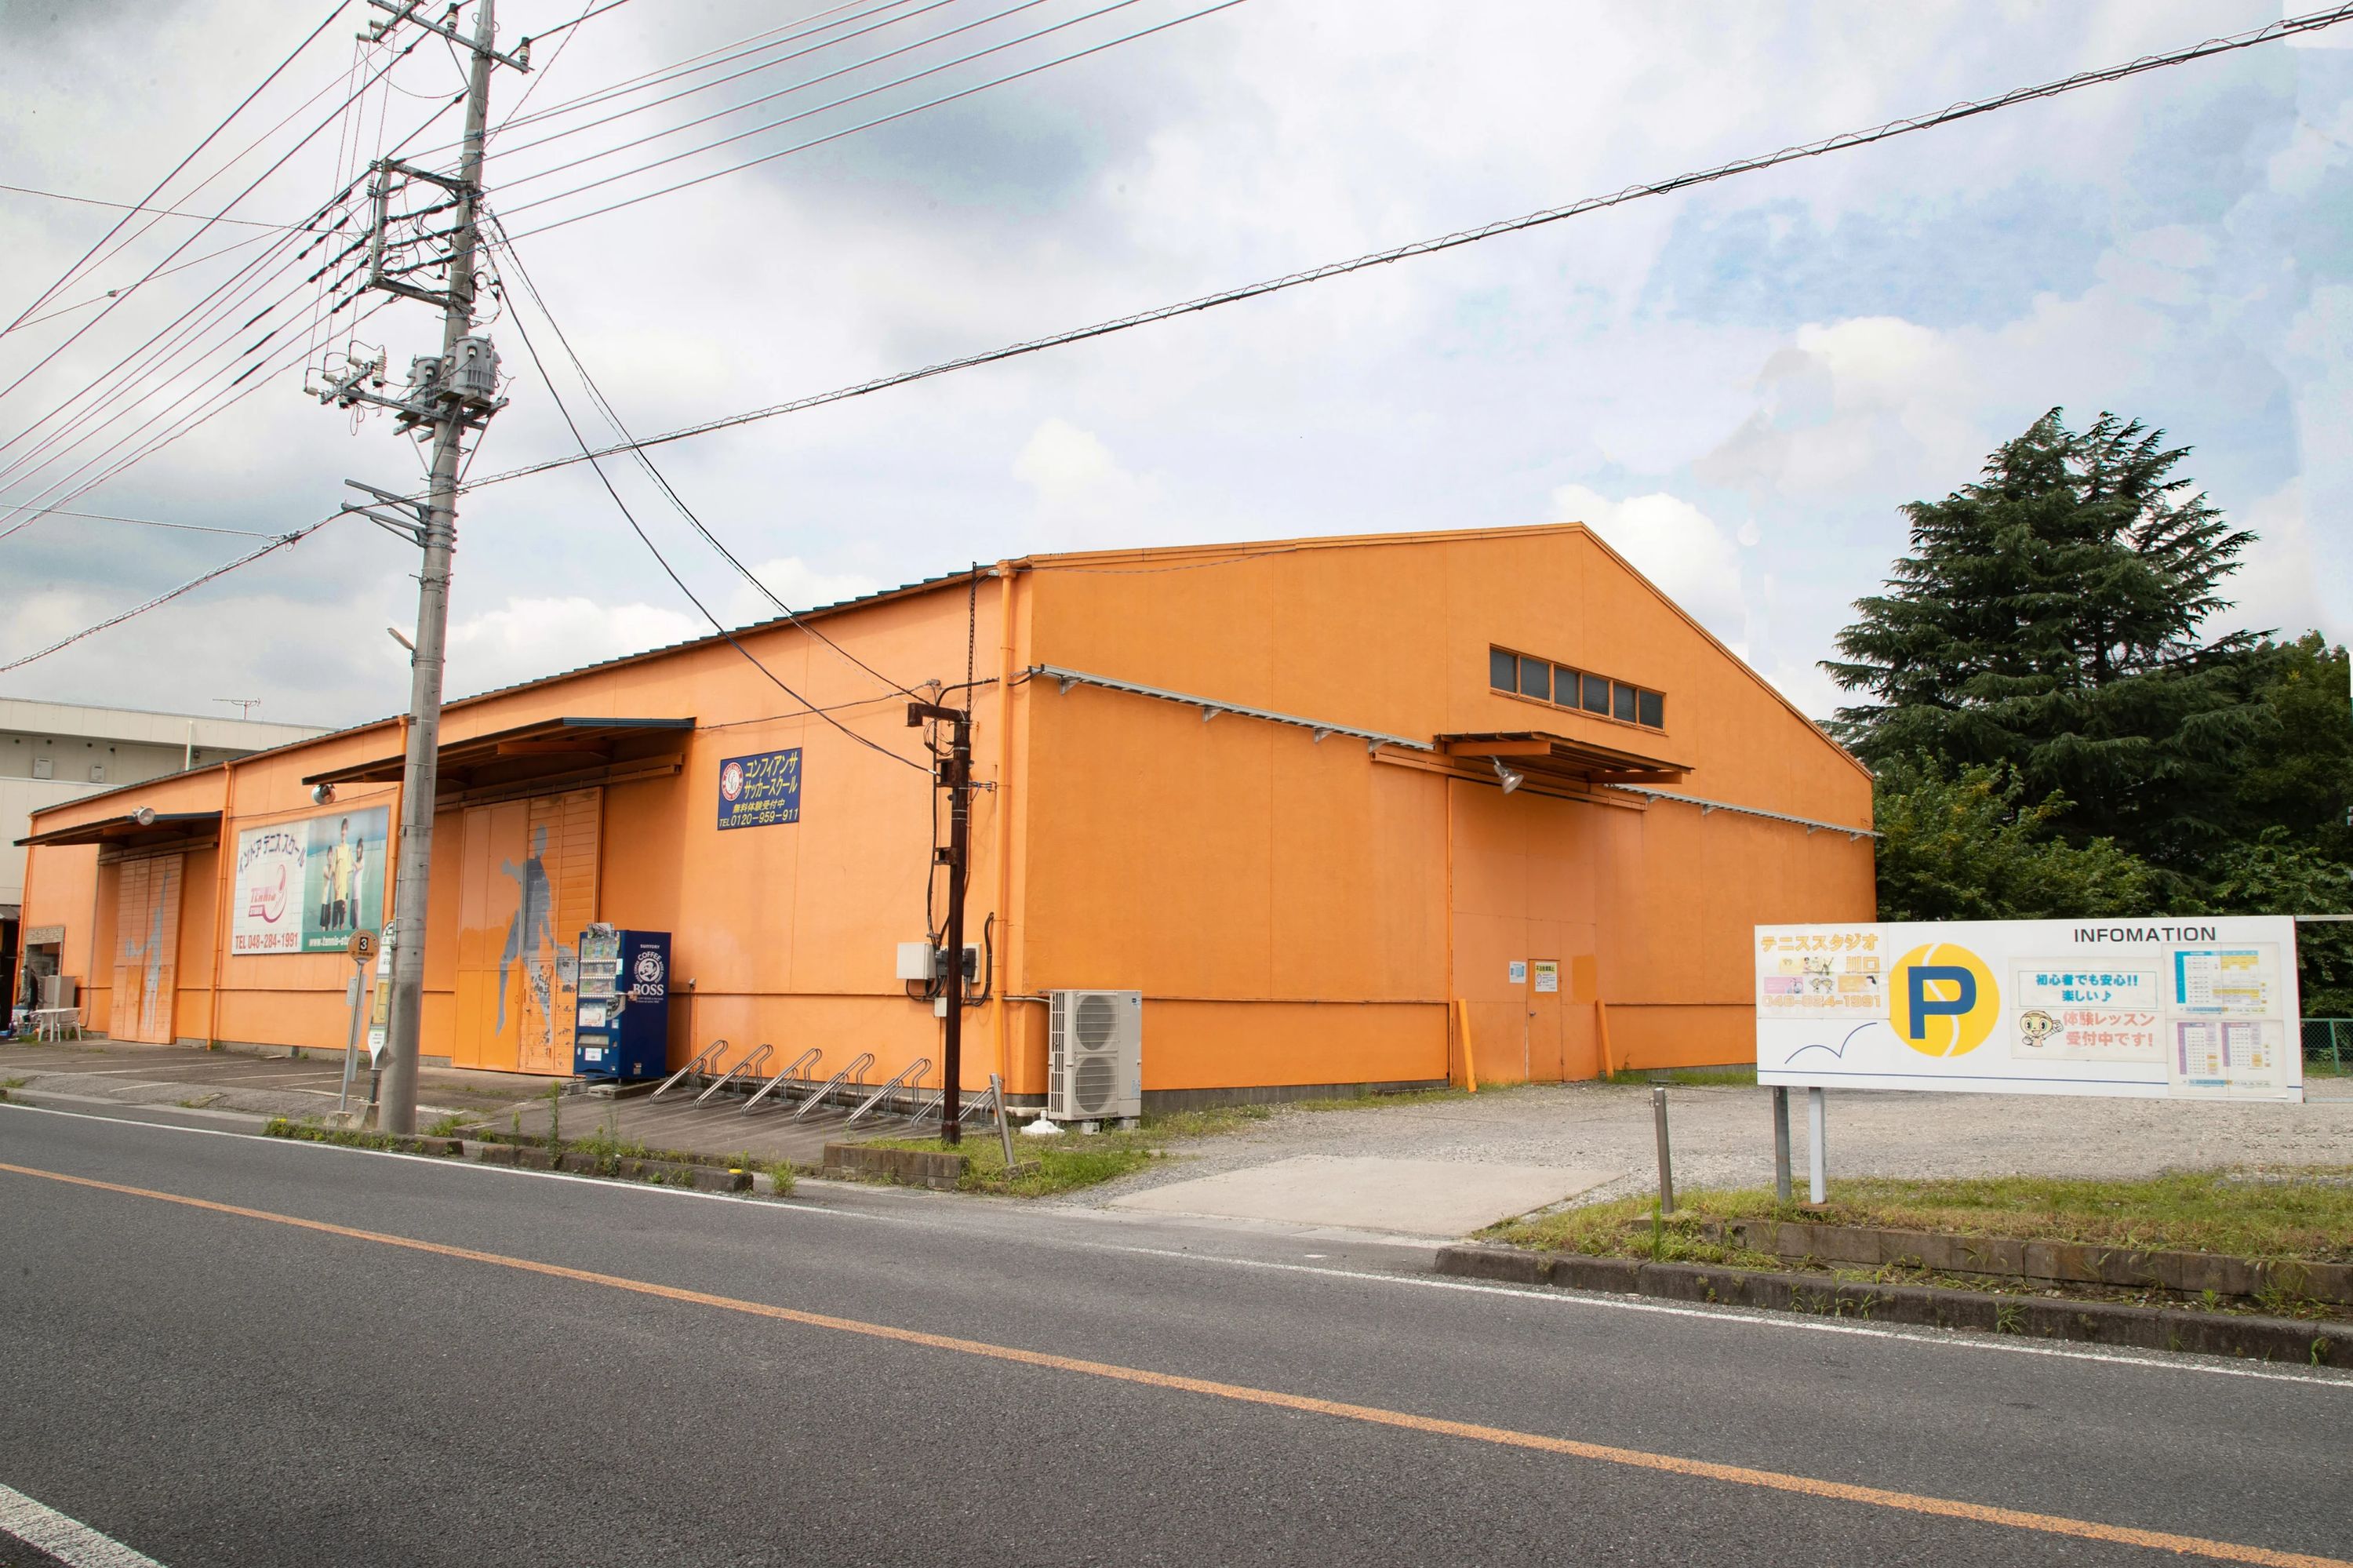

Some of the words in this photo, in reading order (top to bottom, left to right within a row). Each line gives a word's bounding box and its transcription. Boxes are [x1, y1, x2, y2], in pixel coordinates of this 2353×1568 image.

[745, 751, 798, 778] コンフィアンサ
[744, 775, 798, 799] サッカースクール
[733, 799, 785, 813] 無料体験受付中
[235, 935, 246, 949] TEL
[248, 932, 298, 949] 048-284-1991
[1761, 933, 1878, 951] テニススタジオ
[2074, 927, 2216, 942] INFOMATION
[360, 937, 367, 950] 3
[638, 951, 662, 961] COFFEE
[1846, 955, 1879, 973] 川口
[632, 983, 664, 996] BOSS
[1907, 966, 1977, 1039] P
[2062, 1010, 2155, 1027] 体験レッスン
